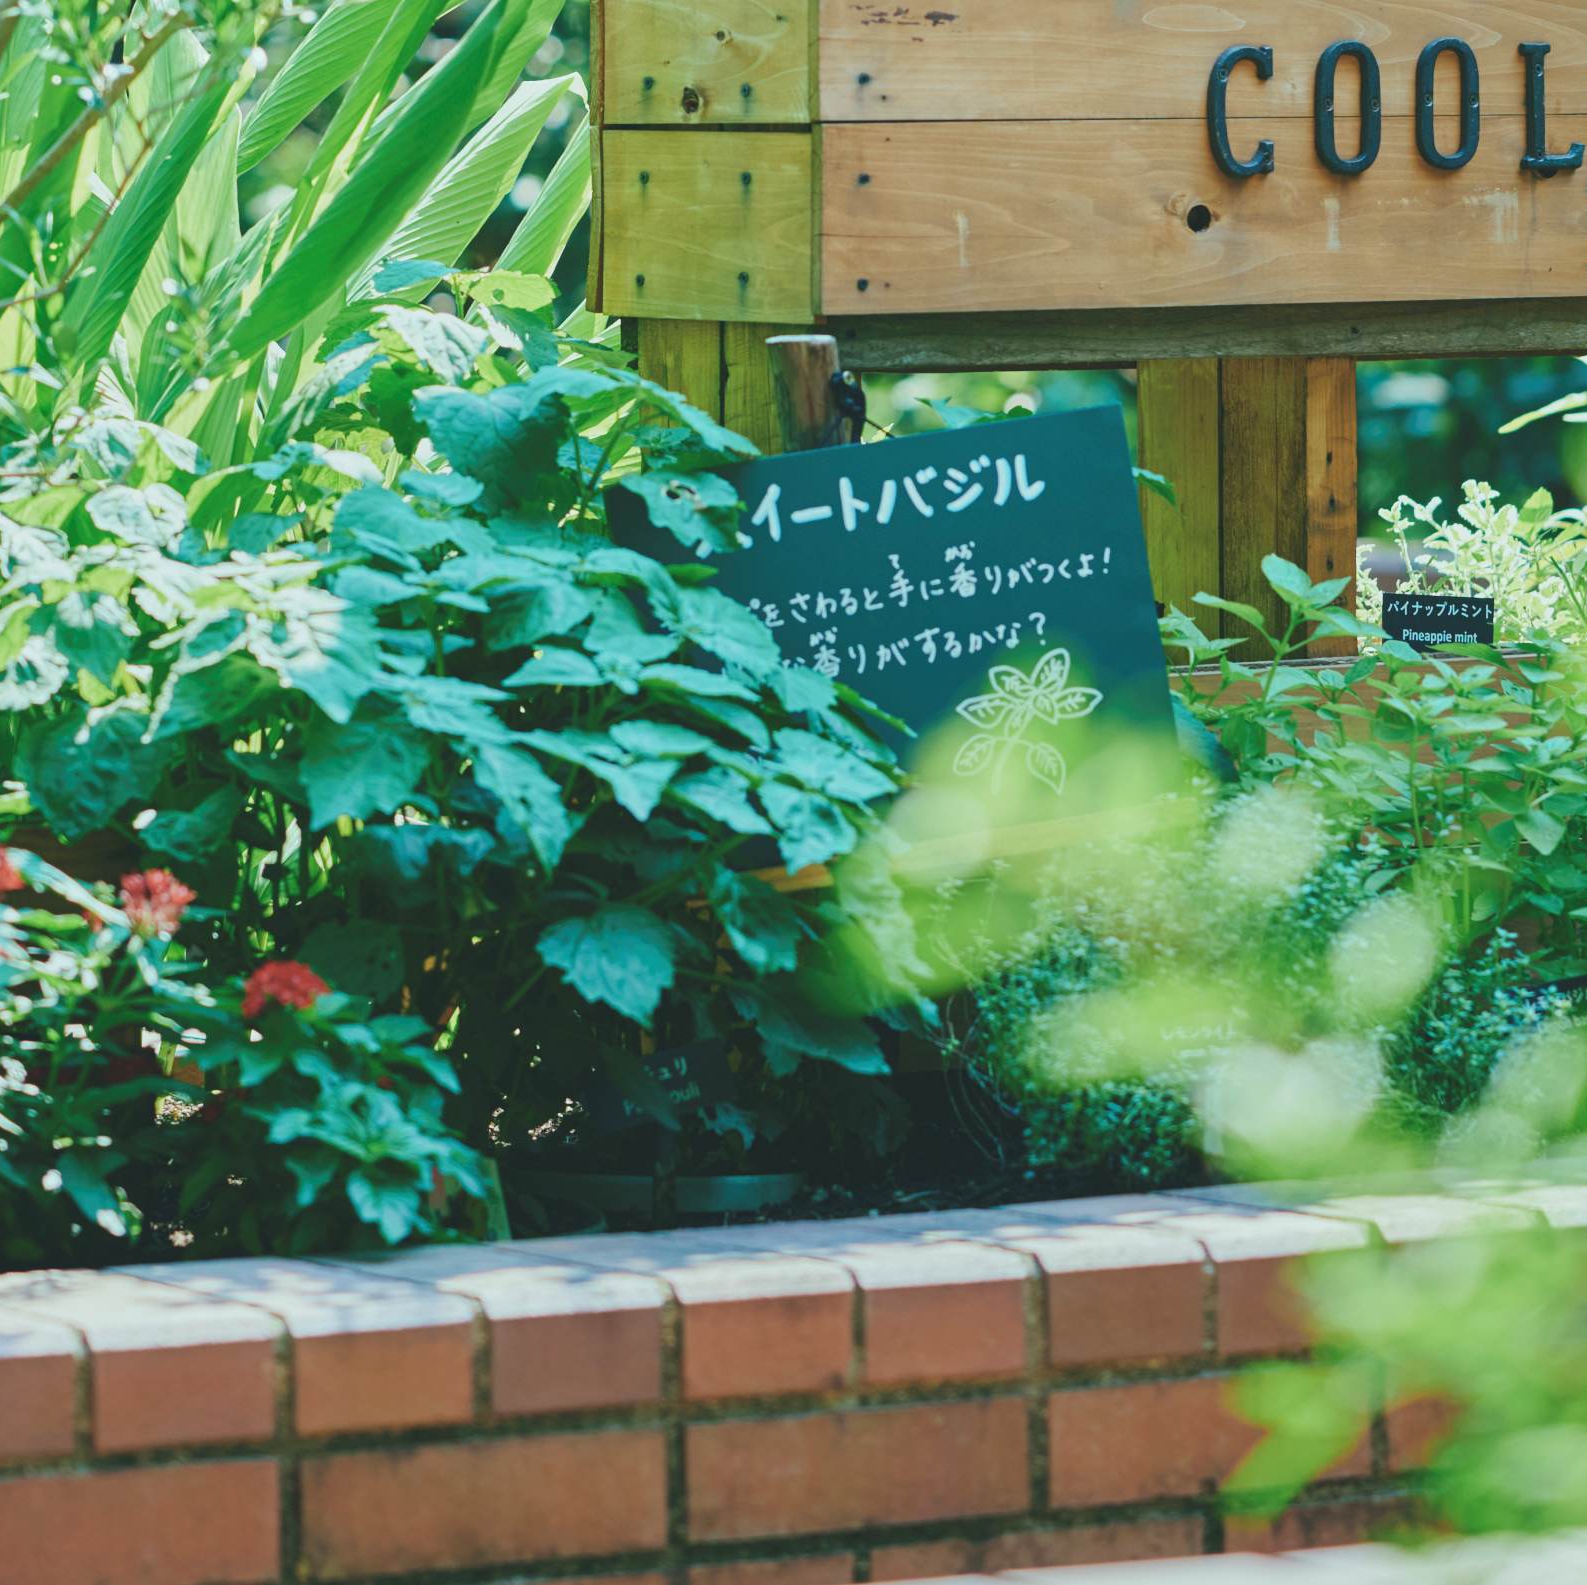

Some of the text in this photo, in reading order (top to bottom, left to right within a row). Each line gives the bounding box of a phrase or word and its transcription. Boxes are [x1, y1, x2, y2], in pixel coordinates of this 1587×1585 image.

[1206, 37, 1586, 179] COOL
[696, 454, 1046, 560] イートバジル
[749, 547, 1111, 628] をさわると手に香りがつくよ!
[1387, 600, 1493, 619] パイナップルミント
[781, 612, 1046, 678] 香りがするかな?
[1455, 631, 1478, 644] mint
